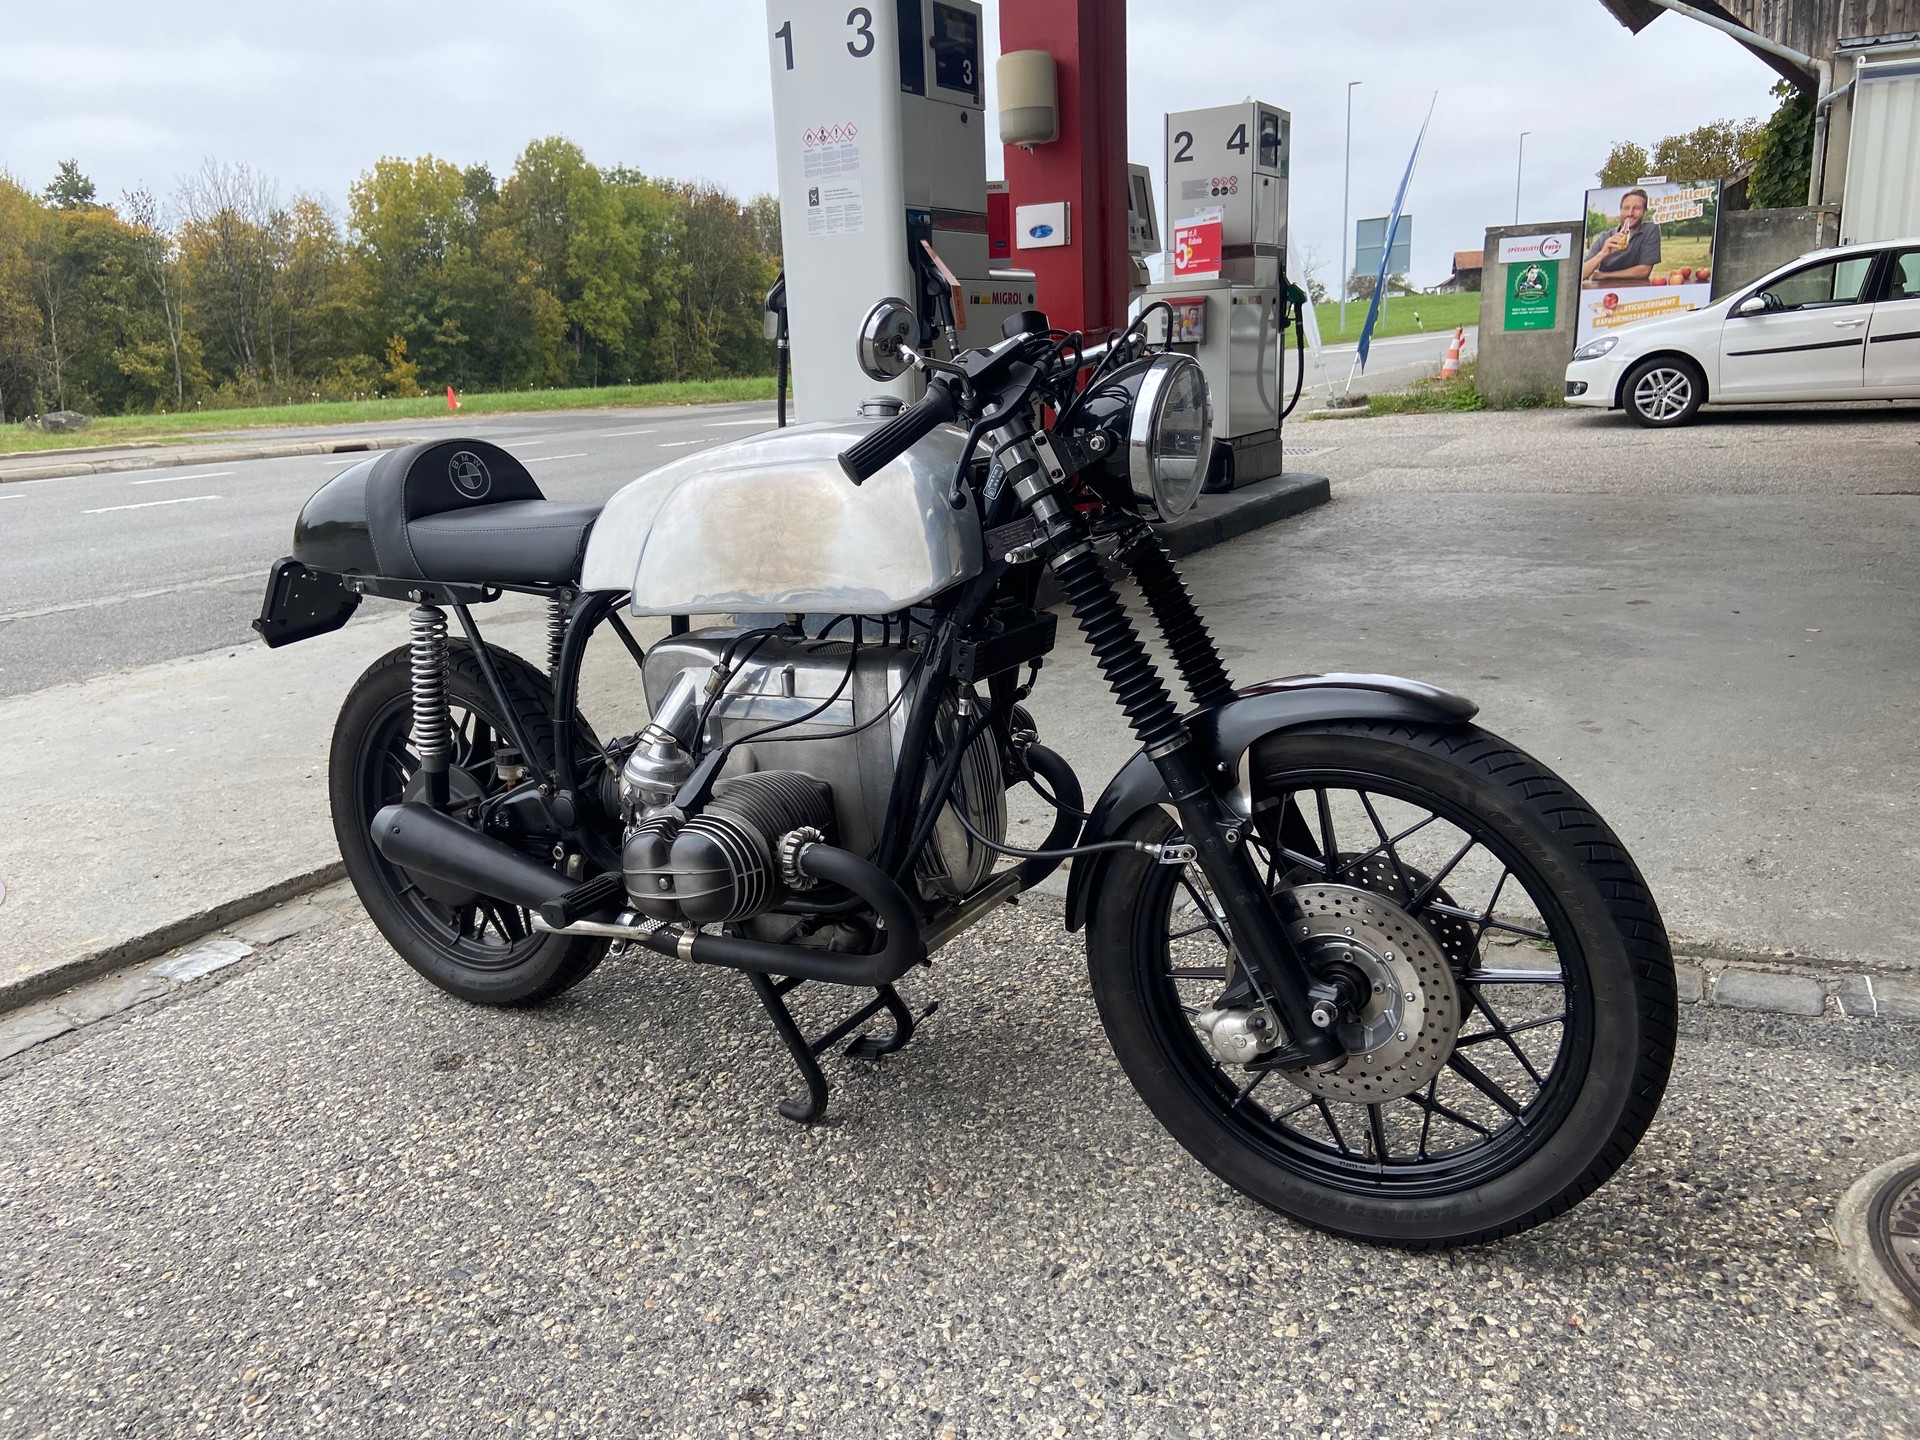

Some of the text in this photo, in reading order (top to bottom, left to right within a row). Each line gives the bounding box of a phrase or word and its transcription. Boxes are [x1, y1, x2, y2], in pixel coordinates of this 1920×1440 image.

[774, 7, 875, 71] 1 3
[962, 59, 973, 85] 3
[1173, 123, 1249, 163] 2 4
[1648, 188, 1713, 207] Le meilleur
[1654, 205, 1702, 222] terroirs!
[1188, 237, 1202, 245] Rabais
[1507, 245, 1539, 254] SPÉCIALISTE
[1175, 230, 1188, 270] 5
[992, 291, 1022, 305] MIGROL
[1615, 298, 1677, 313] PARTICULIÈREMENT
[452, 455, 479, 468] BMW
